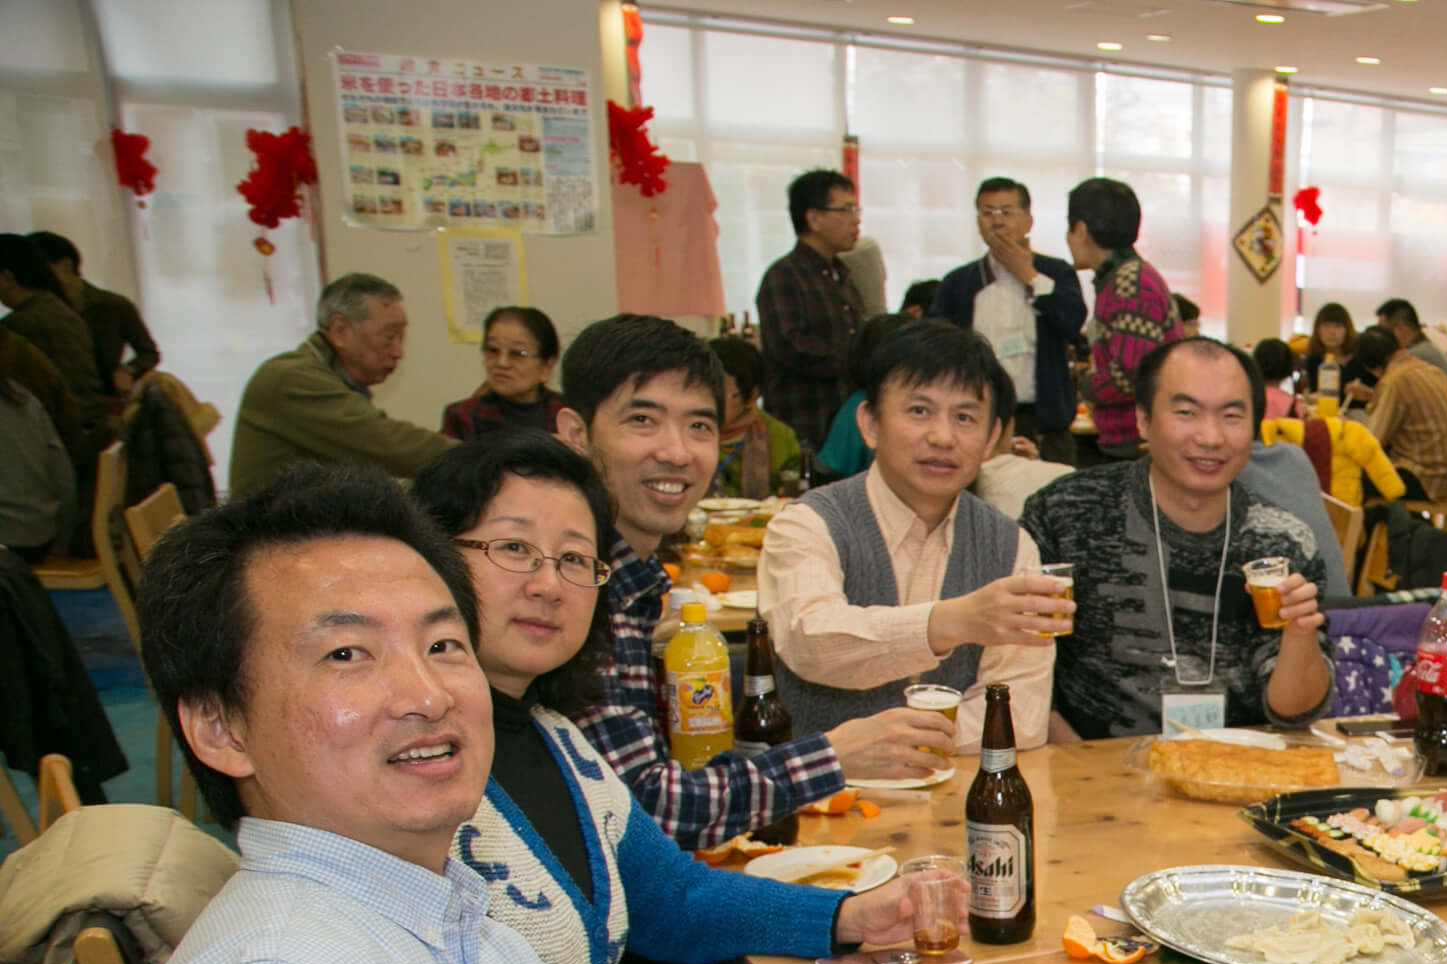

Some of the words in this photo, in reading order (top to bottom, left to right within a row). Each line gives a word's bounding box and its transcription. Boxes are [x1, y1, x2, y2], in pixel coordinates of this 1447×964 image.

[340, 74, 588, 107] 米を使った日本各地の郷土料理
[967, 854, 1014, 877] Asahi
